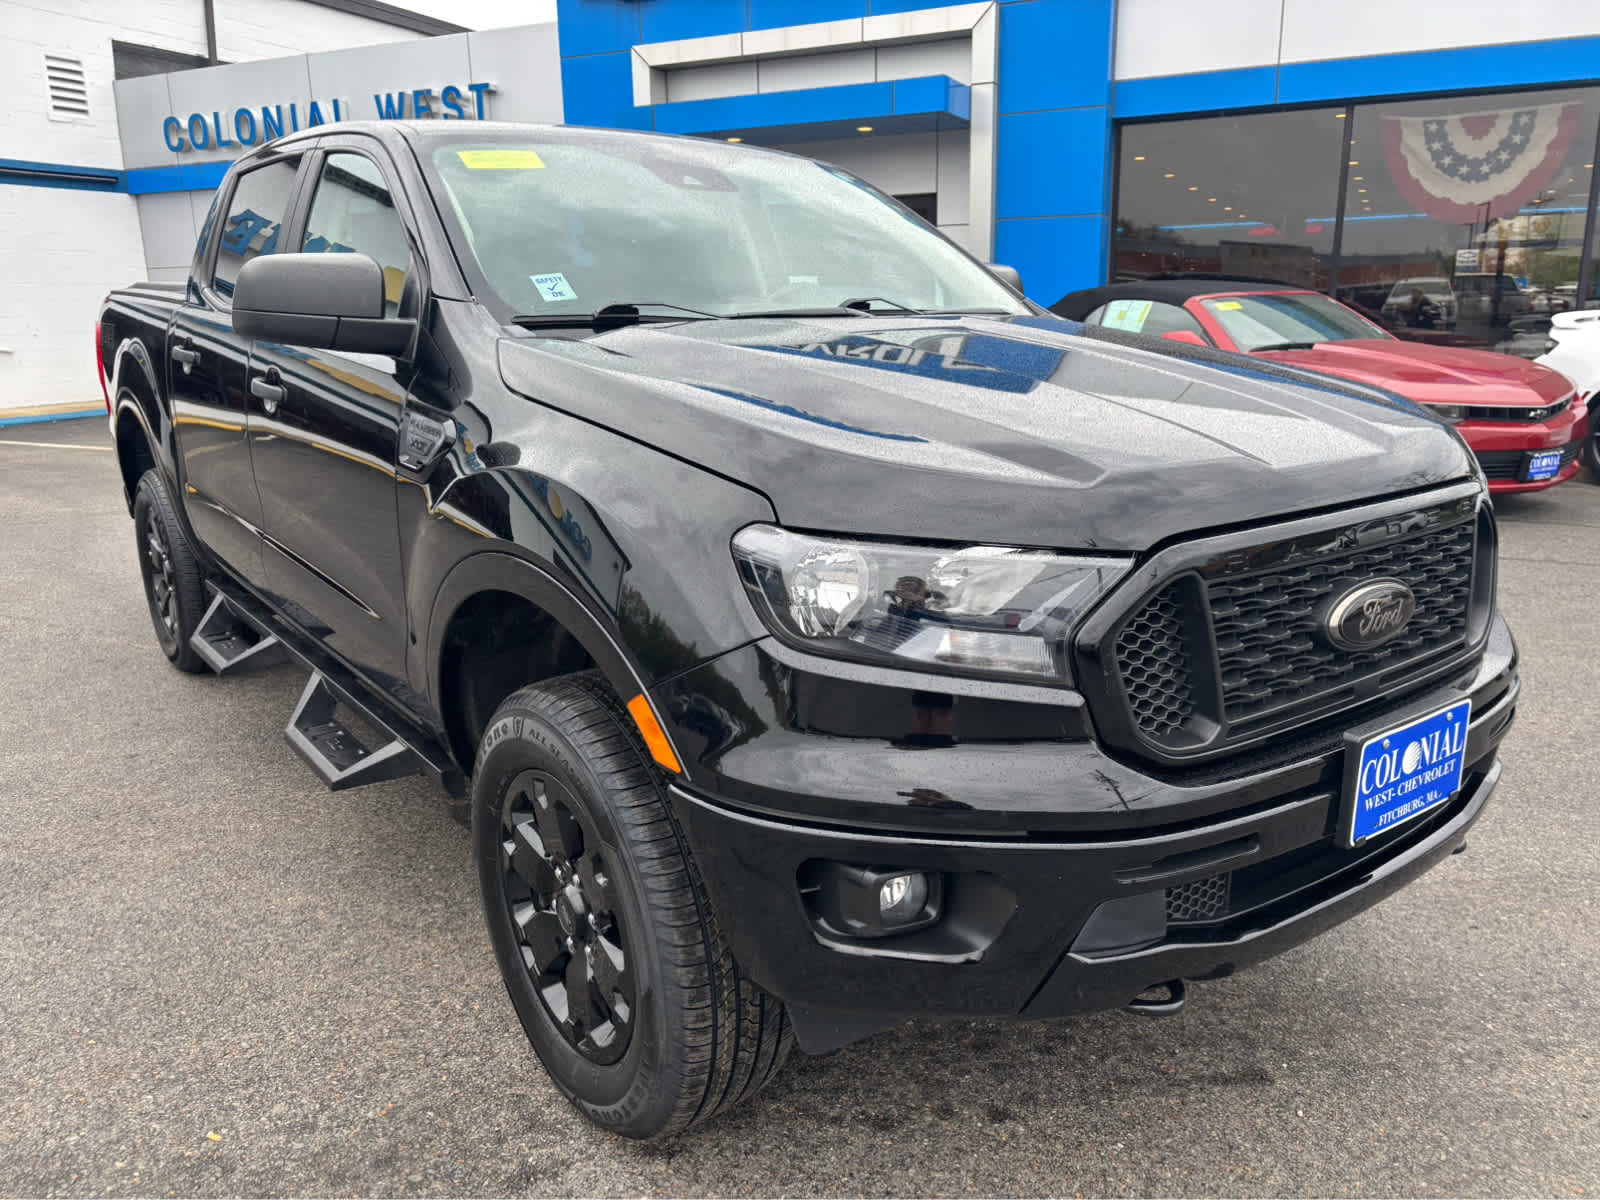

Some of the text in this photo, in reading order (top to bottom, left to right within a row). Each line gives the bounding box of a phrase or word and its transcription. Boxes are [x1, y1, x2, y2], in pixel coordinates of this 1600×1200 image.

[374, 82, 491, 120] WEST
[1359, 595, 1404, 637] Ford
[1361, 721, 1464, 796] COLONIAL
